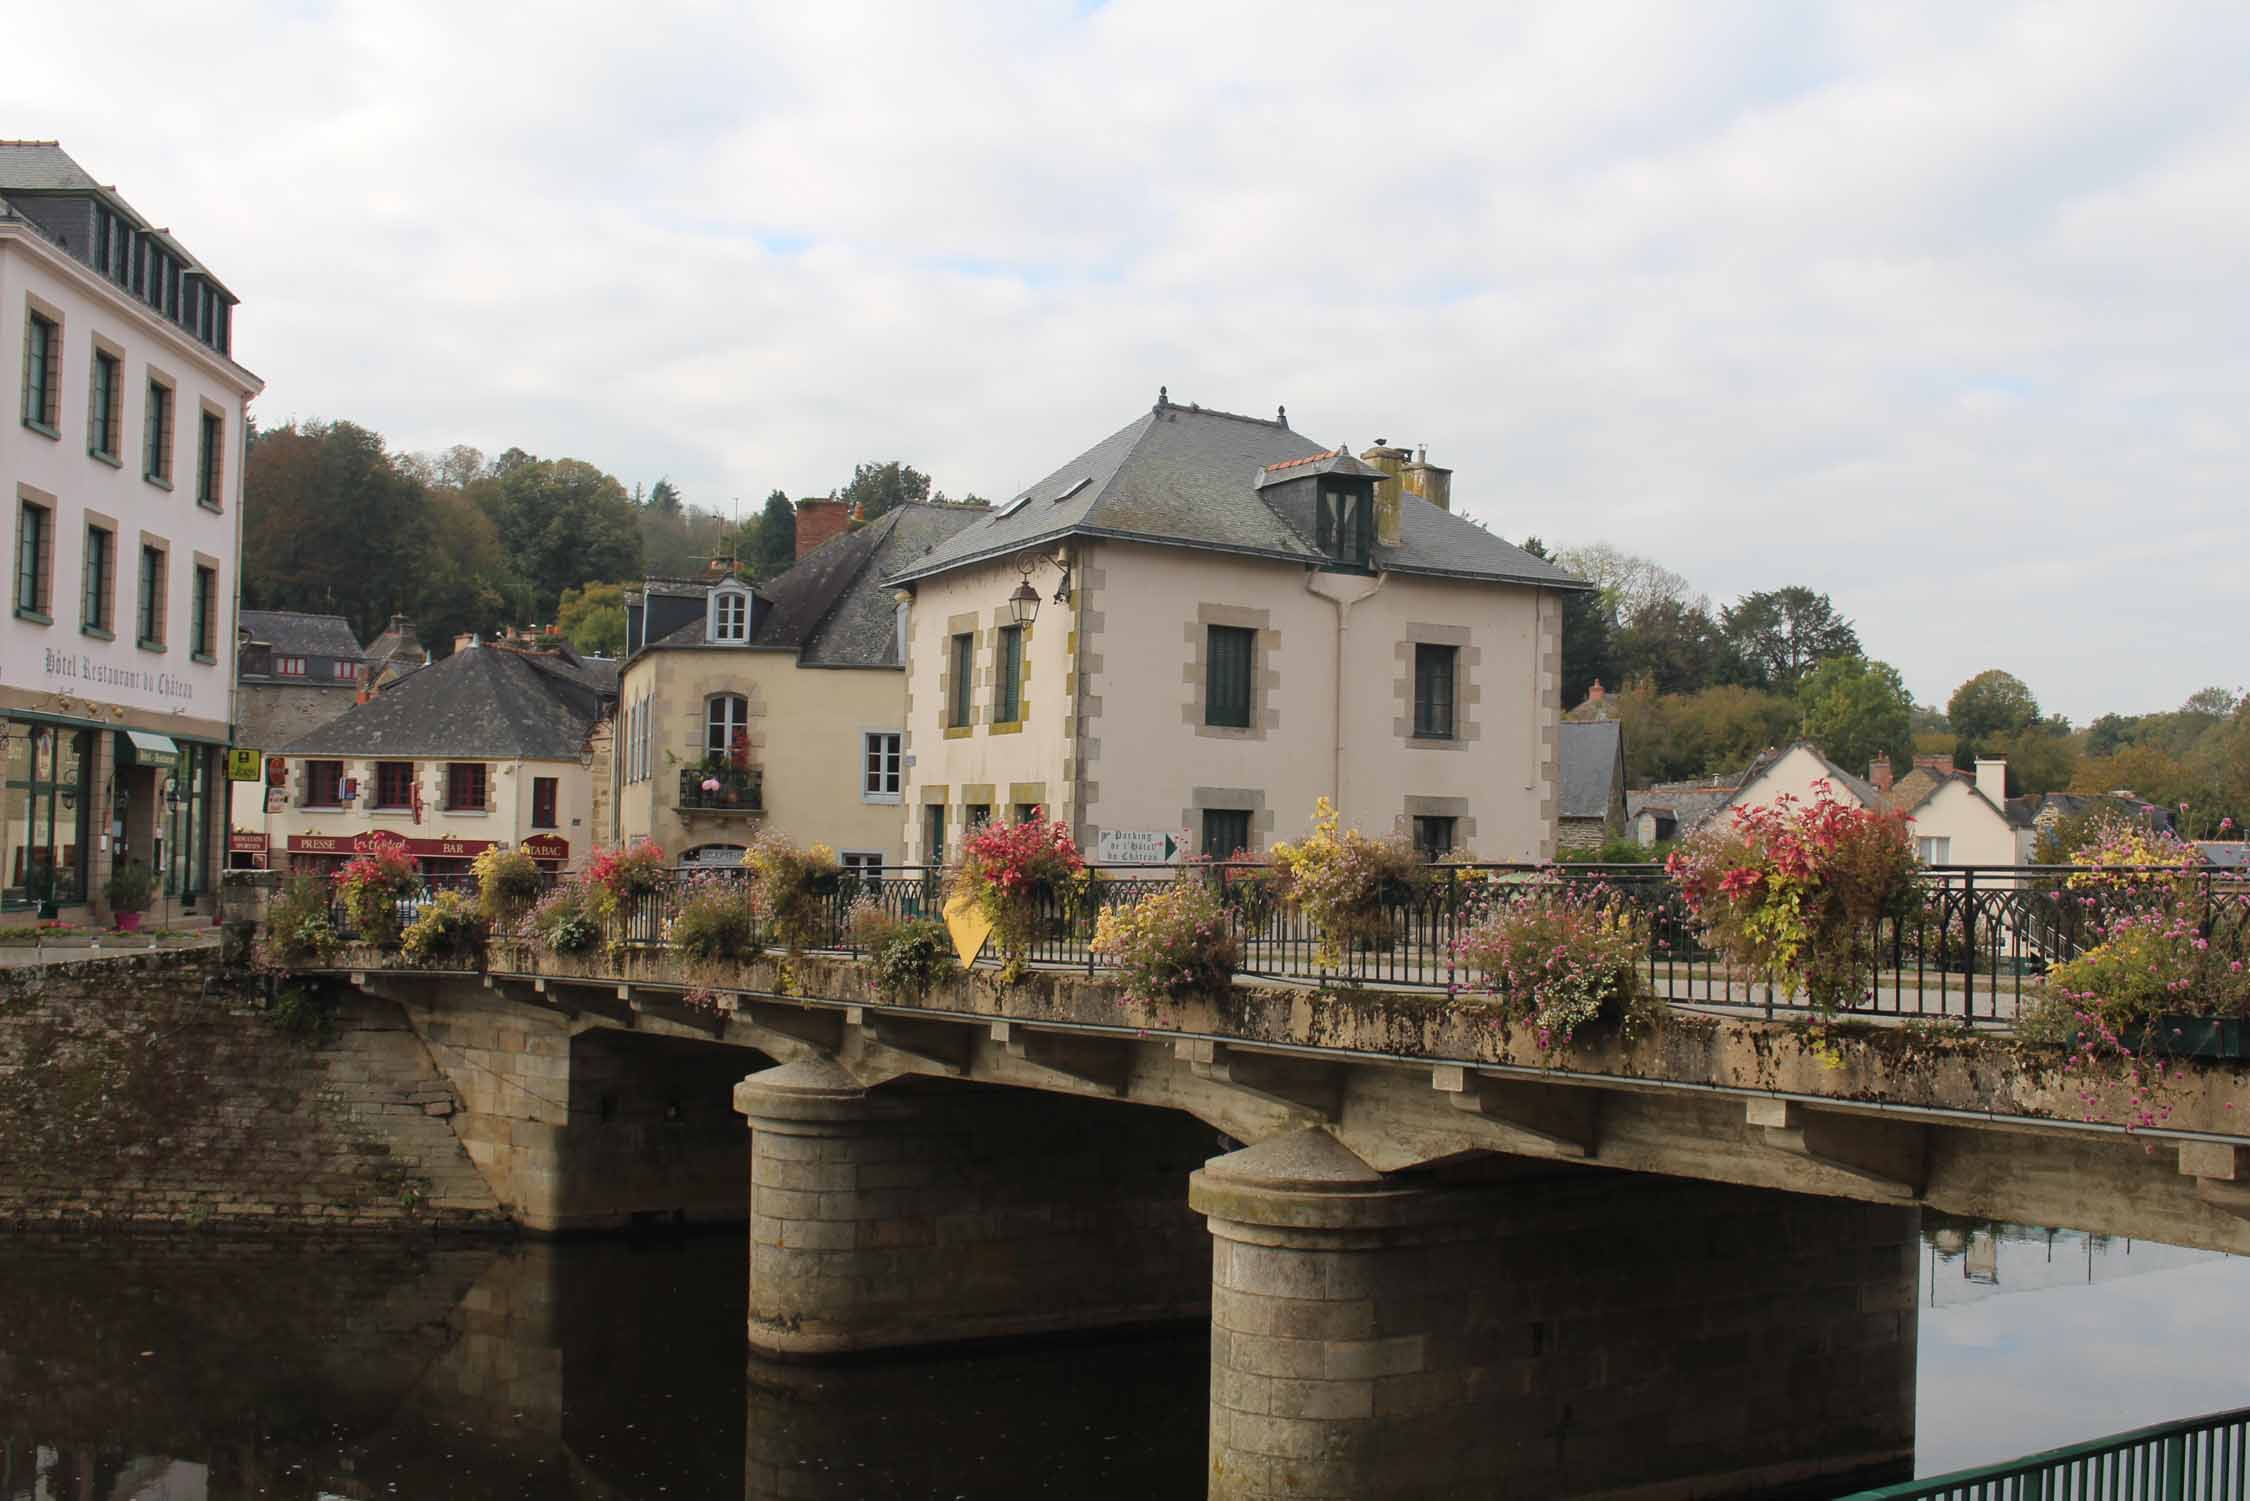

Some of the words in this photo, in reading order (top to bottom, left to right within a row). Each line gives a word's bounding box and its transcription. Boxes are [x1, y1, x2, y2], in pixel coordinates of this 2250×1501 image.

[83, 655, 140, 690] Restaurant
[143, 671, 154, 693] du
[301, 839, 336, 849] PRESSE
[443, 843, 464, 854] BAR
[529, 845, 561, 856] TABAC
